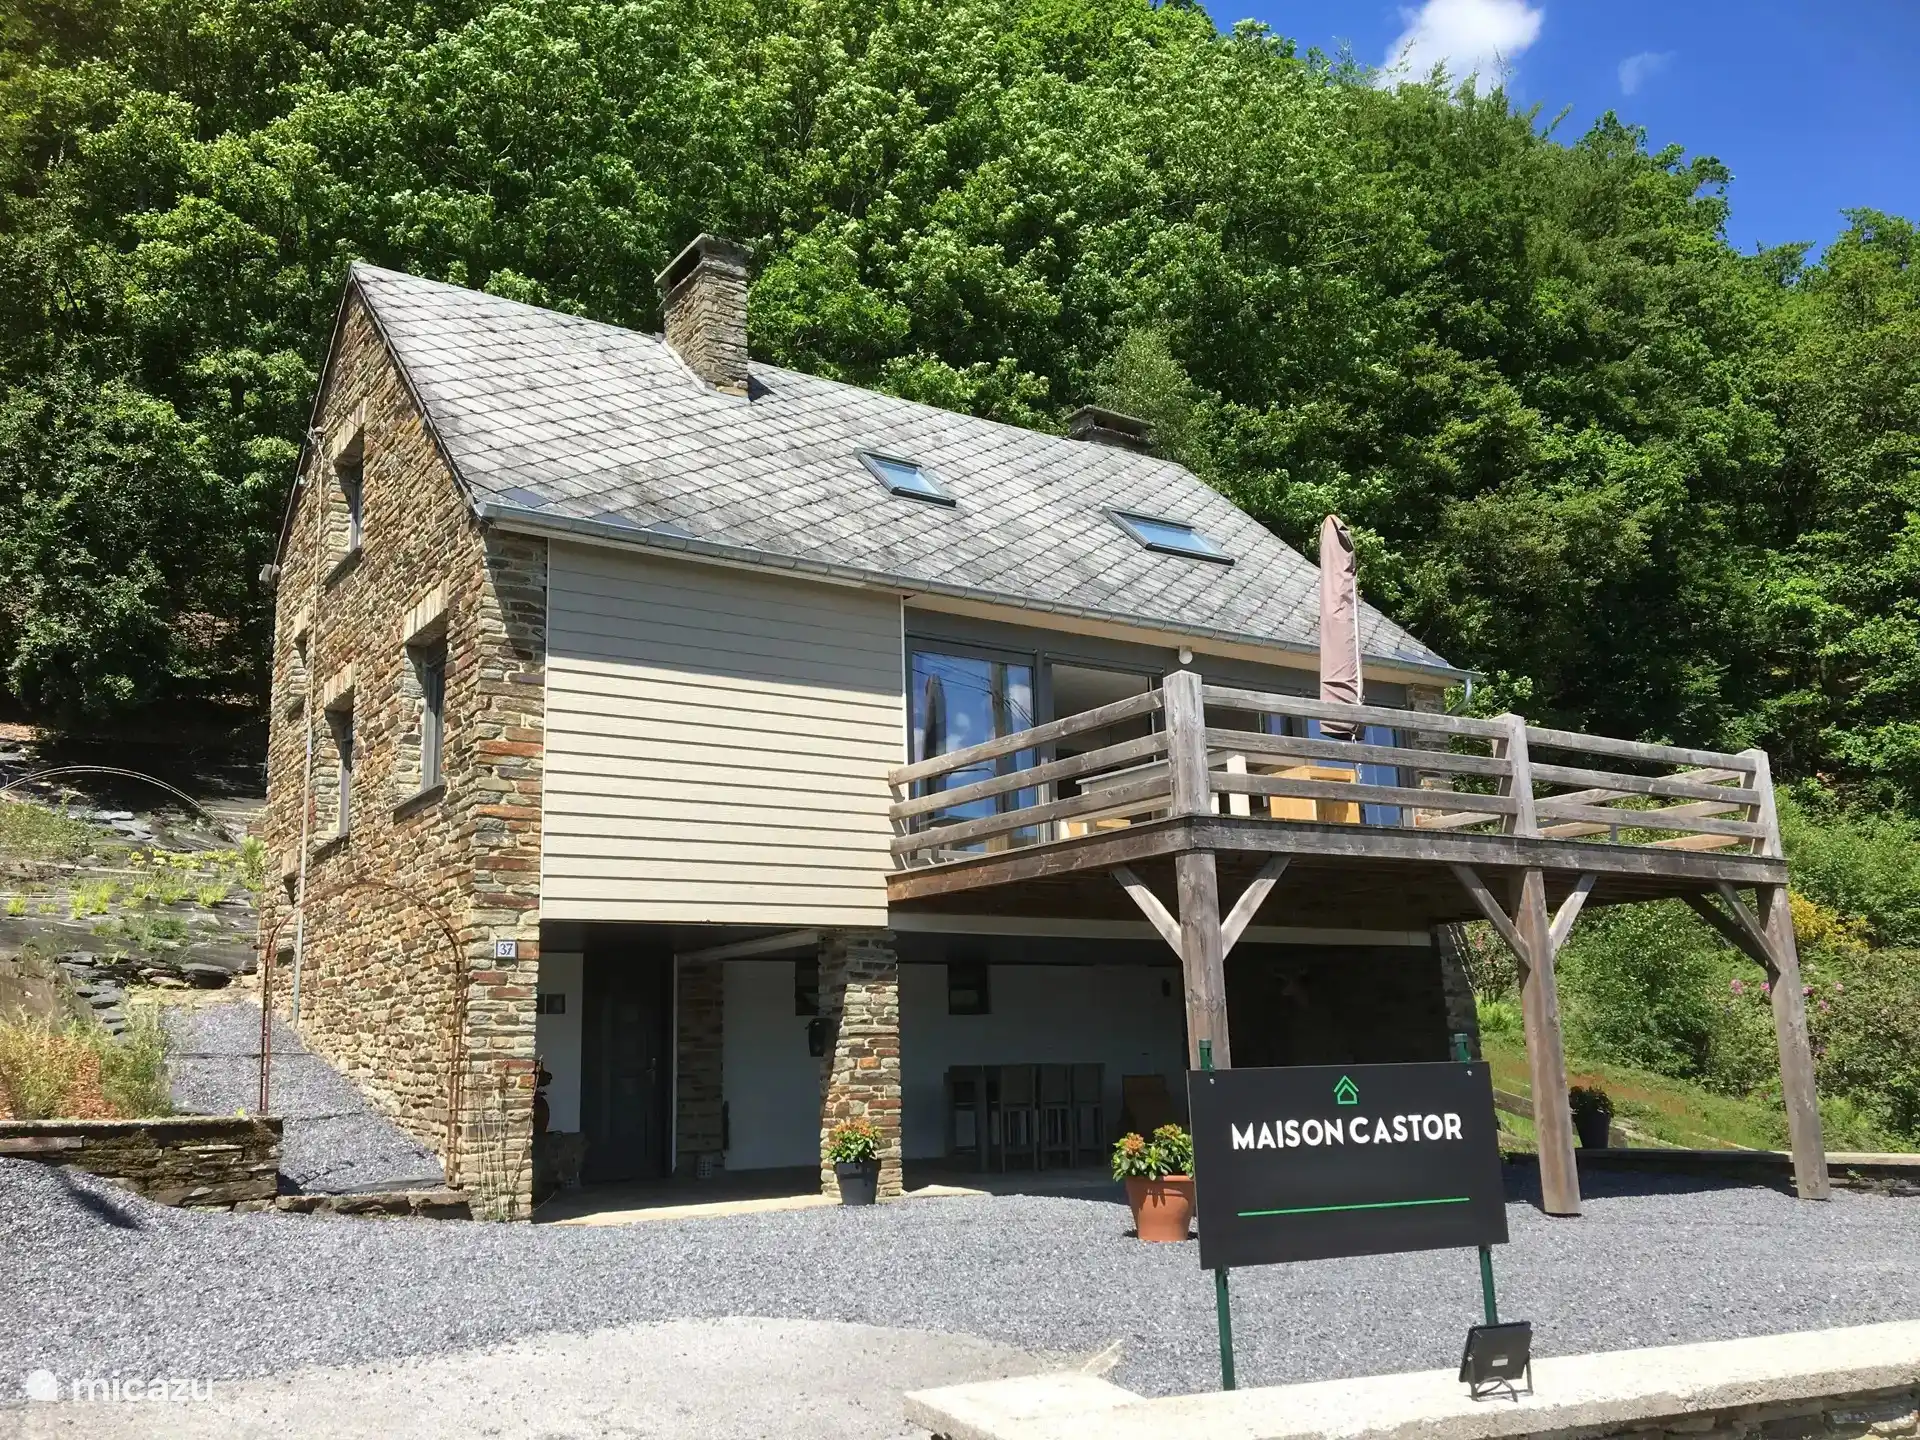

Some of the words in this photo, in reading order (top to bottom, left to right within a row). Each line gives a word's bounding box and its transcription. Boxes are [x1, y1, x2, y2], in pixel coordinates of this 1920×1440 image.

[499, 943, 513, 956] 37
[1231, 1117, 1344, 1150] MAISON
[1349, 1113, 1463, 1144] CASTOR
